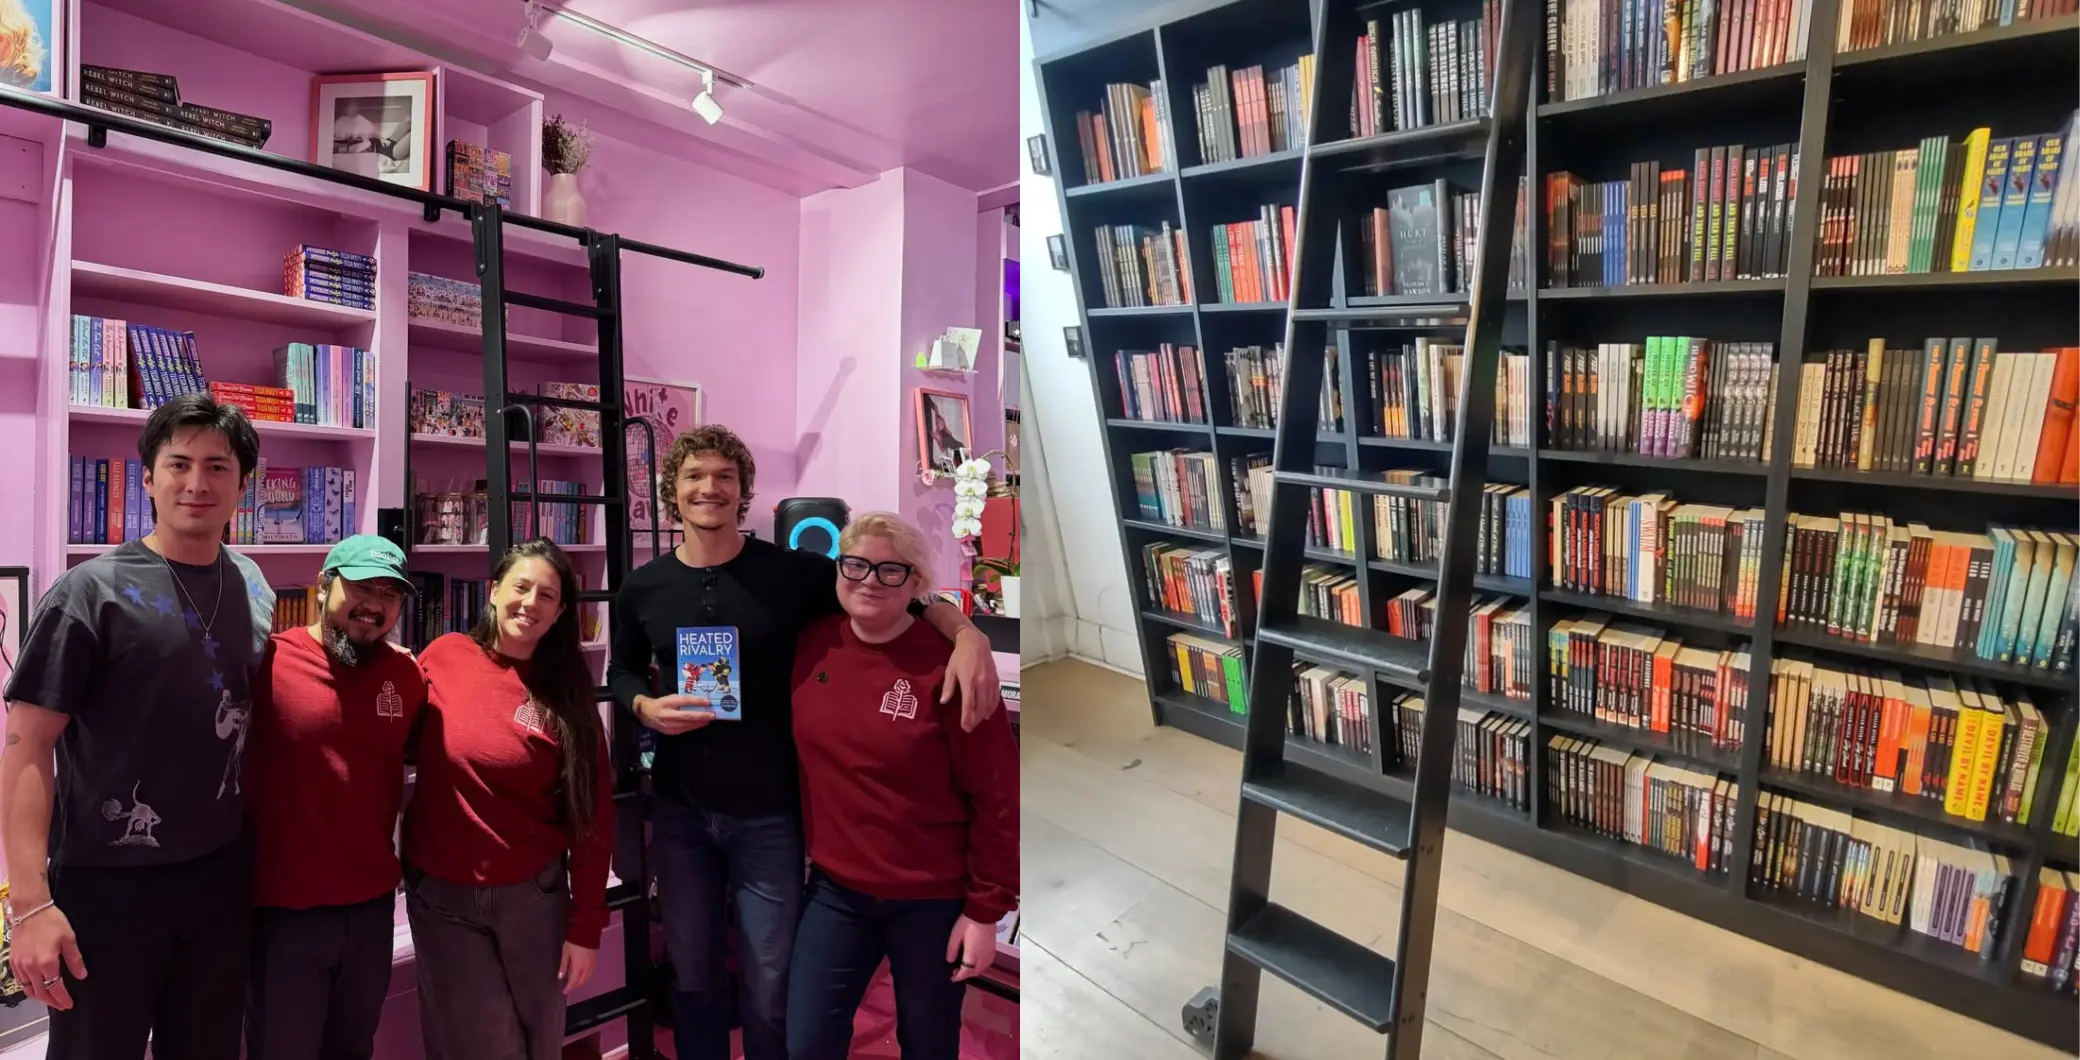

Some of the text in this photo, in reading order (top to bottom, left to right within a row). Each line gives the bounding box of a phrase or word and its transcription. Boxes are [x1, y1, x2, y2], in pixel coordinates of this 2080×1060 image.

[1448, 23, 1457, 92] DEAD SILENCE
[1547, 16, 1557, 52] GARDEN
[1429, 28, 1438, 96] DEAD SILENCE
[1439, 56, 1448, 95] SILENCE
[85, 84, 107, 96] REBEL
[110, 90, 135, 104] WITCH
[202, 116, 225, 128] WITCH
[1400, 229, 1426, 239] HURT
[1692, 206, 1705, 262] AND THEN SHE FELL
[1708, 204, 1721, 261] AND THEN SHE FELL
[1724, 203, 1737, 261] AND THEN SHE FELL
[679, 632, 733, 645] HEATED
[680, 644, 733, 656] RIVALRY
[1953, 724, 1976, 802] DEVIL BY NAME
[1972, 729, 1997, 807] DEVIL BY NAME
